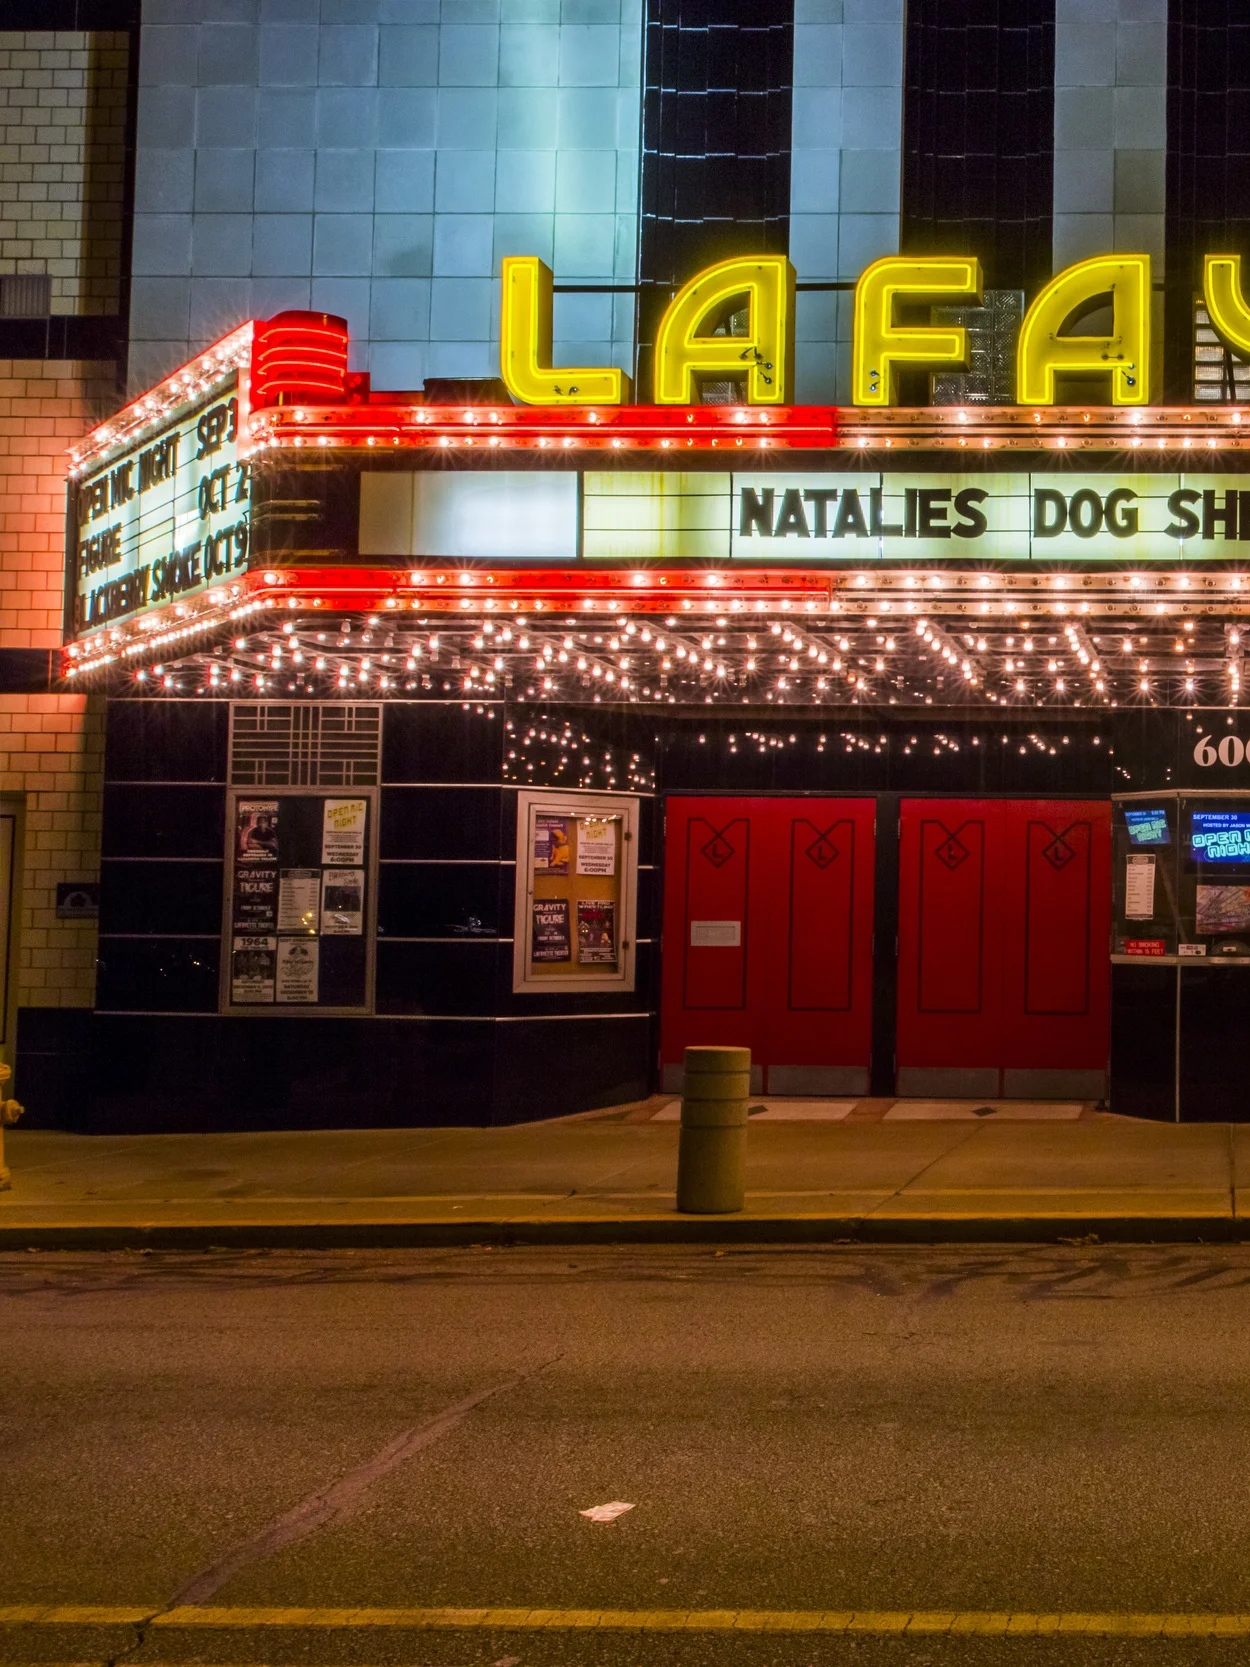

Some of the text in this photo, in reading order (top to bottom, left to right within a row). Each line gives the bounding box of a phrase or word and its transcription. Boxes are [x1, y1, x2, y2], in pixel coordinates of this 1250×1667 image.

[110, 459, 135, 510] MIC
[139, 431, 180, 495] NIGHT
[199, 463, 231, 521] OCT
[740, 487, 989, 539] NATALIES
[1033, 488, 1139, 539] DOG
[152, 540, 202, 602] SMOKE
[1192, 830, 1241, 848] OPEN
[238, 870, 277, 879] GRAVITY
[533, 903, 567, 911] GRAVITY
[241, 938, 269, 946] 1964
